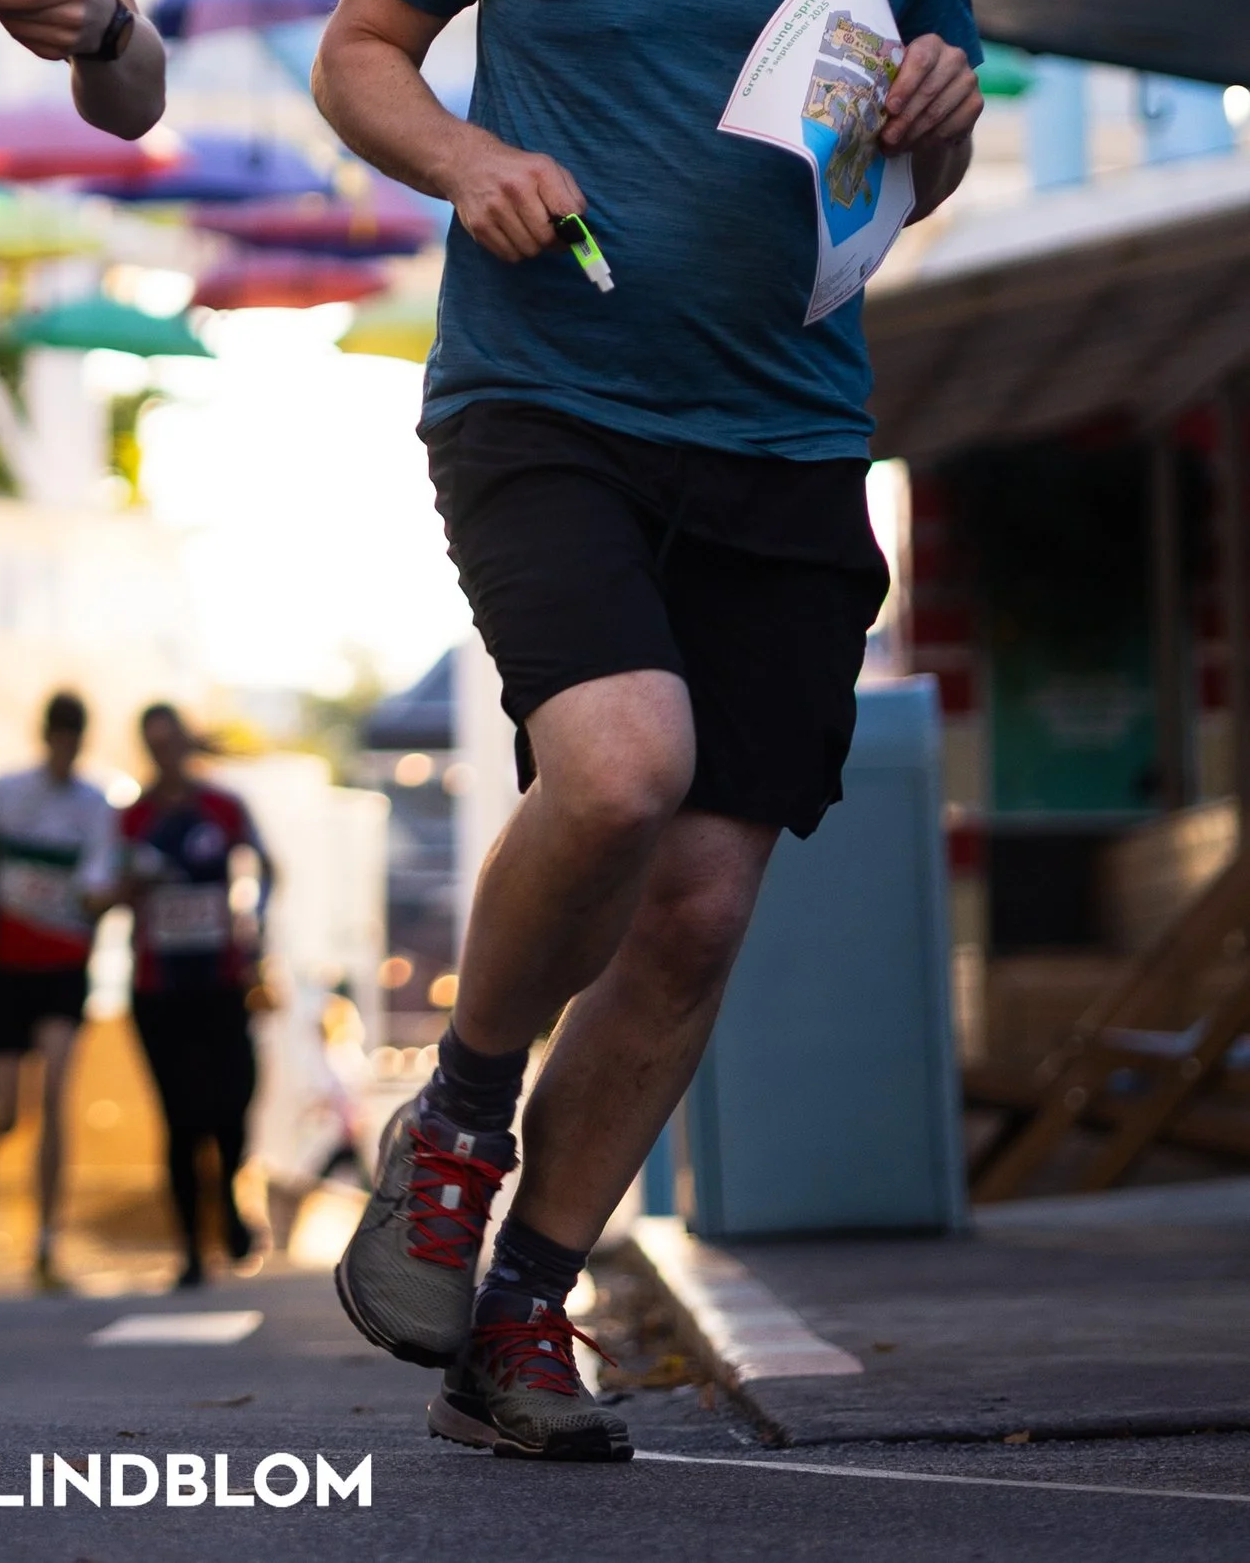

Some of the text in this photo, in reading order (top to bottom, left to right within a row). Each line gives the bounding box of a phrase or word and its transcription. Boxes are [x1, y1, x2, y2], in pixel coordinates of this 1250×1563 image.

[773, 21, 811, 66] september
[809, 0, 830, 21] 2025
[742, 55, 770, 97] Gröna
